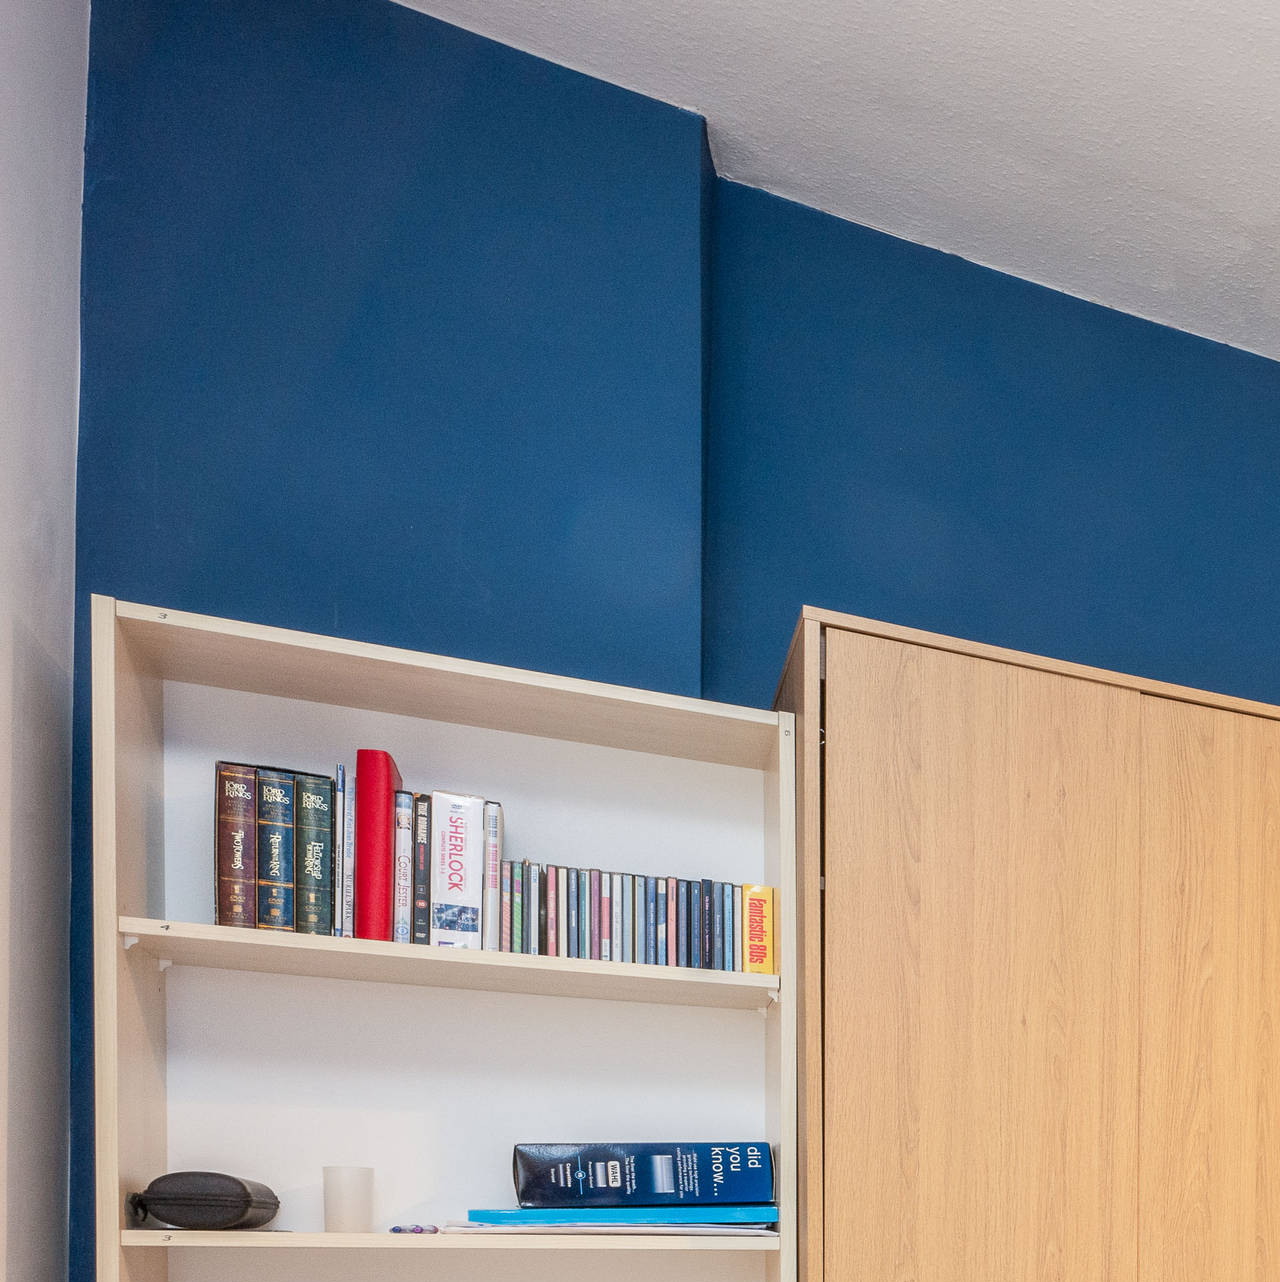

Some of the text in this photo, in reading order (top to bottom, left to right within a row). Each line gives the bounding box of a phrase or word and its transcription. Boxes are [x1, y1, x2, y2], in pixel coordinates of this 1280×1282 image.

[448, 816, 465, 892] SHERLOCK
[748, 944, 768, 965] 80s
[725, 1146, 742, 1172] you
[747, 1146, 762, 1168] did
[610, 1163, 619, 1184] WAHL
[711, 1147, 725, 1196] know...
